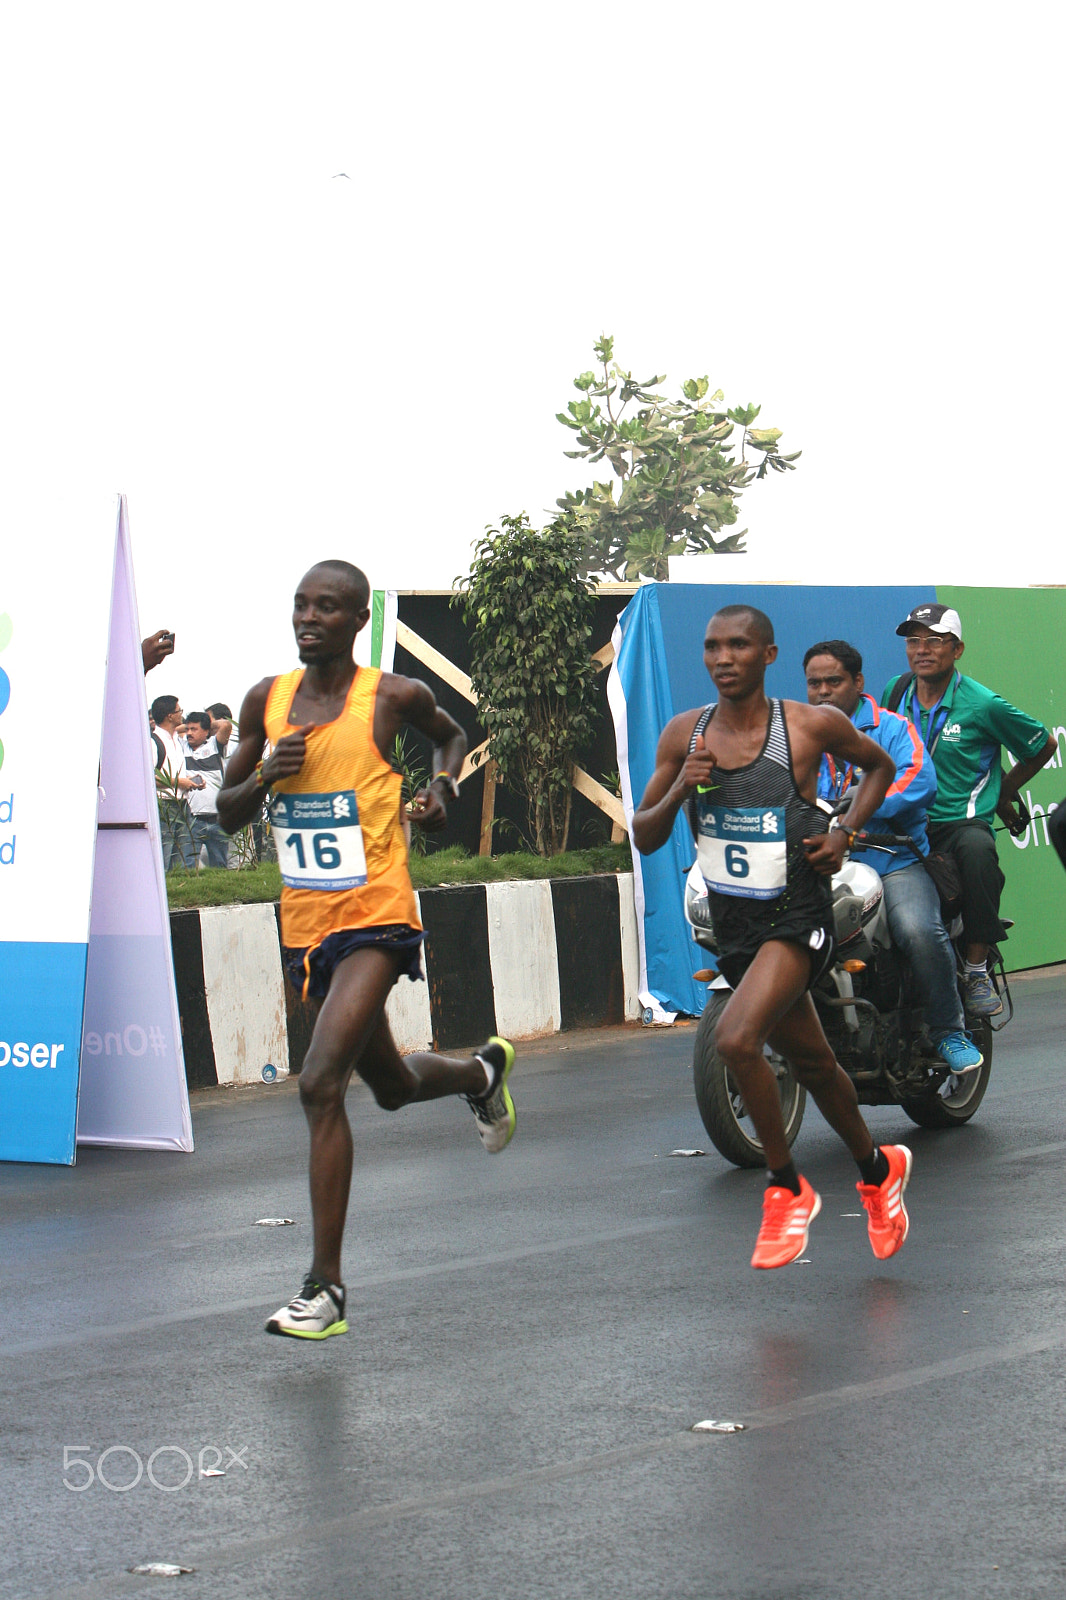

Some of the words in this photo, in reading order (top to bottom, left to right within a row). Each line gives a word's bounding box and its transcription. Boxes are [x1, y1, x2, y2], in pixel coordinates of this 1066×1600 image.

[293, 801, 331, 809] Standard
[292, 809, 332, 819] Chartered
[724, 814, 760, 824] Standard
[722, 822, 760, 832] Chartered
[285, 832, 342, 870] 16
[724, 844, 750, 878] 6
